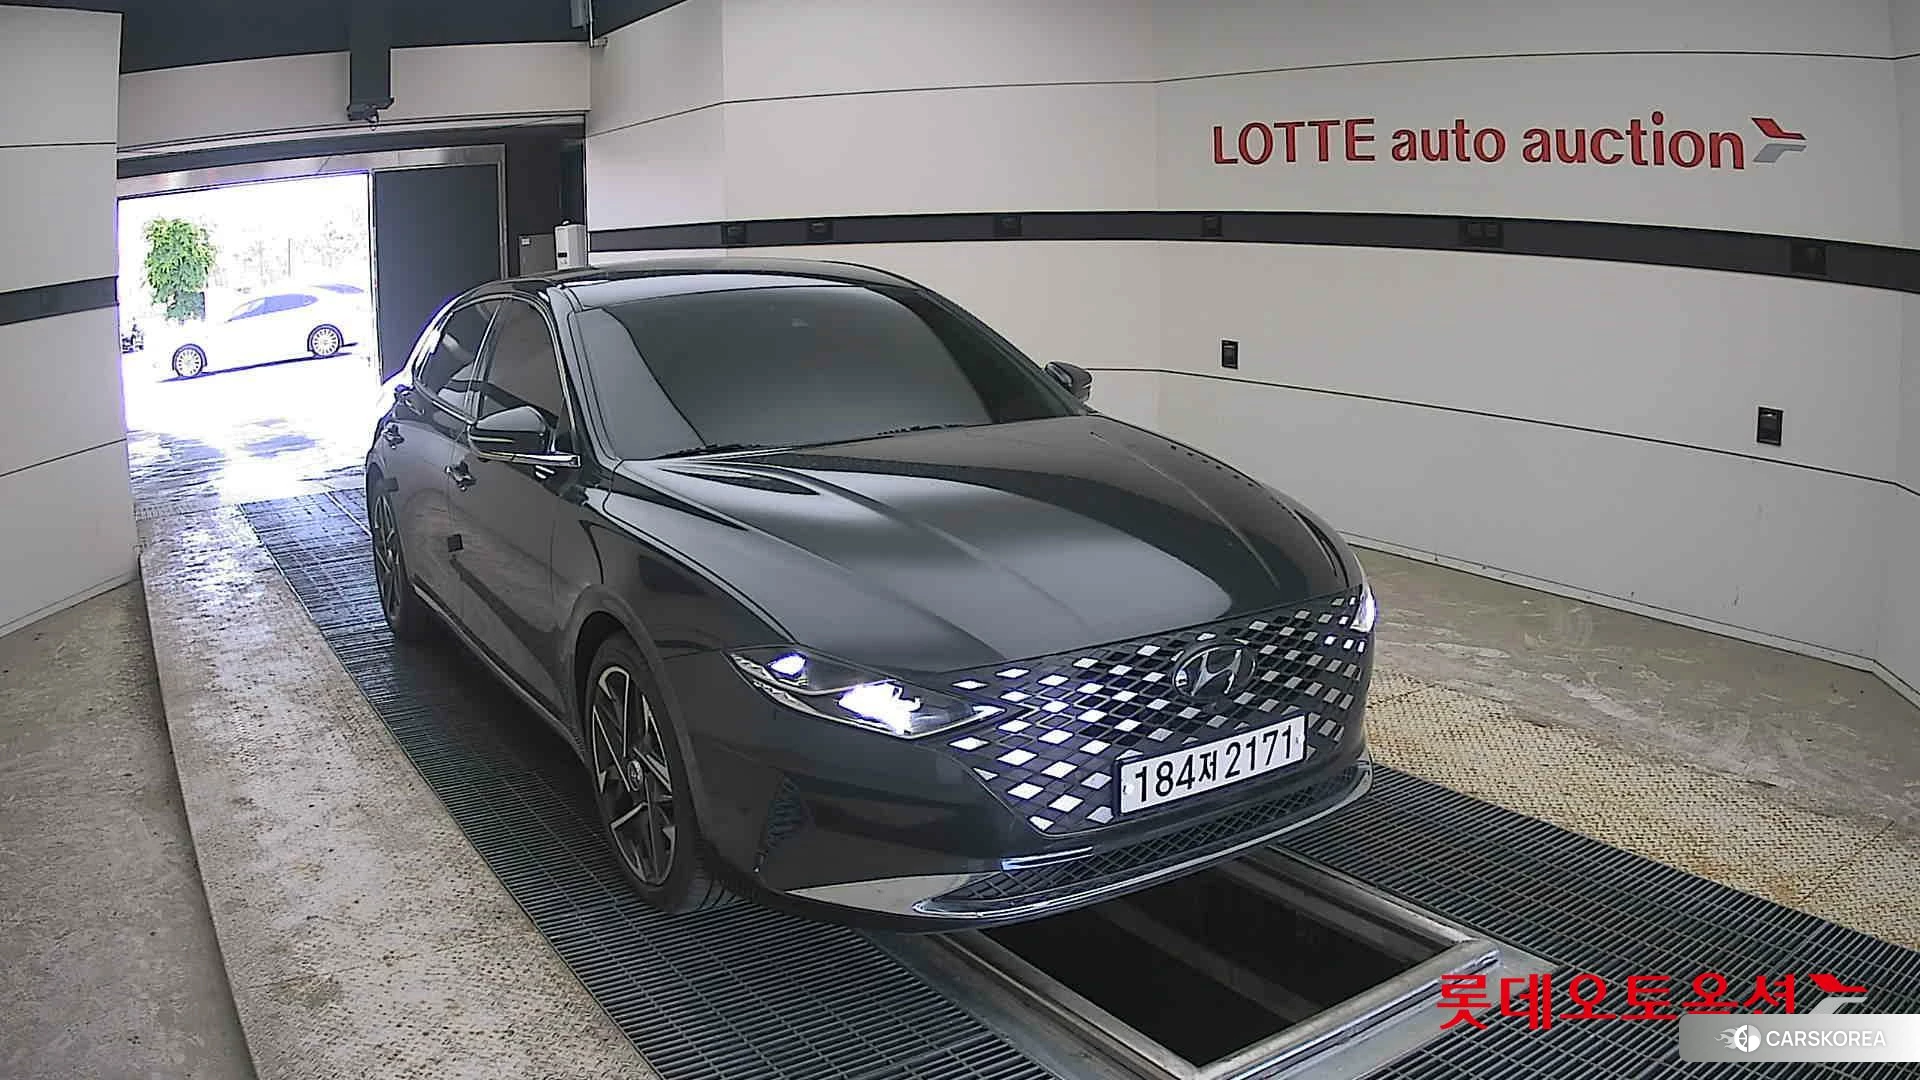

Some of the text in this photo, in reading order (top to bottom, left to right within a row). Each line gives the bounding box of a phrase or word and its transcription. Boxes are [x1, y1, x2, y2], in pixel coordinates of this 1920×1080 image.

[1212, 111, 1746, 171] LOTTE auto auction
[1134, 724, 1294, 803] 184저 2171
